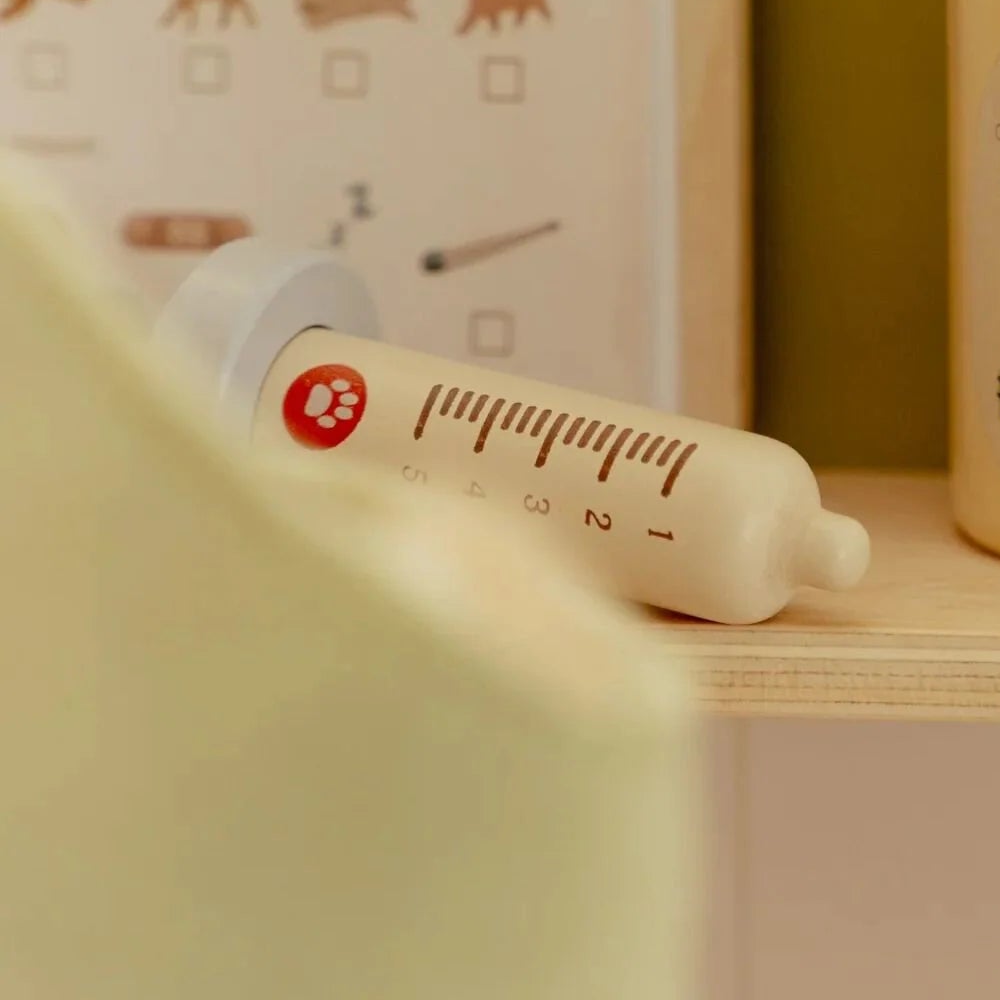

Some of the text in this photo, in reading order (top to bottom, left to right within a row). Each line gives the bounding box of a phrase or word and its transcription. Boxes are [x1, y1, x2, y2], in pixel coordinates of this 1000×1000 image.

[402, 464, 428, 485] 5
[523, 493, 551, 516] 3
[584, 508, 613, 532] 2
[647, 527, 675, 542] 1
